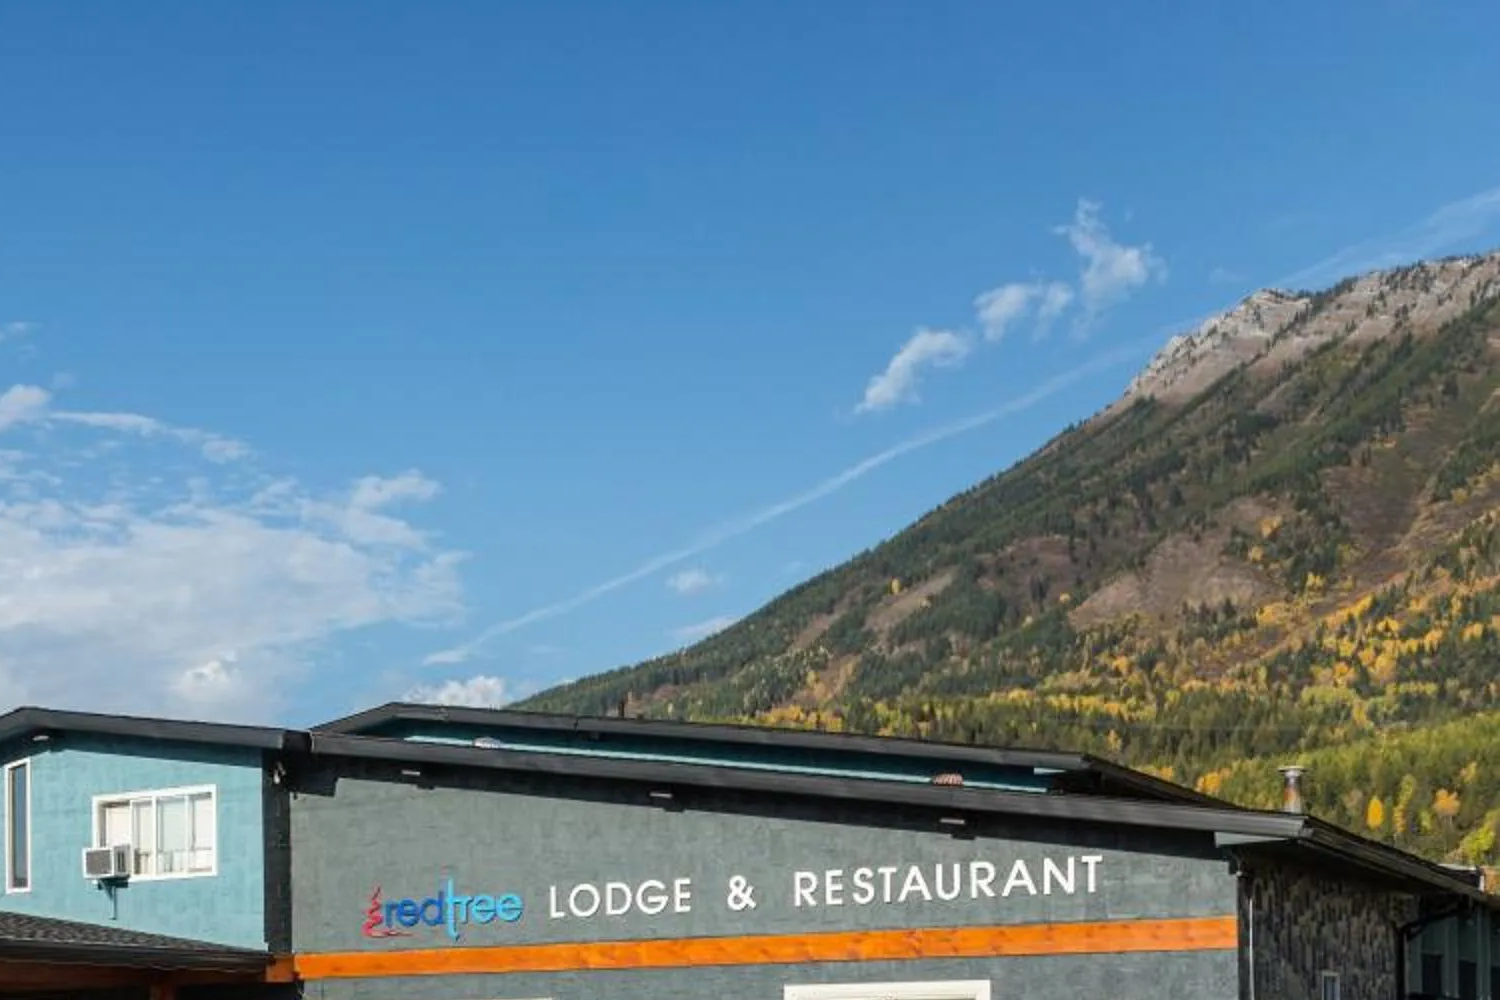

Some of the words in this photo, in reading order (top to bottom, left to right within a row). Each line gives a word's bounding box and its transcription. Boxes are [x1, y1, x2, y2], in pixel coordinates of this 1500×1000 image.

[384, 878, 524, 941] redtree
[549, 878, 692, 919] LODGE
[727, 874, 757, 911] &
[794, 854, 1103, 907] RESTAURANT
